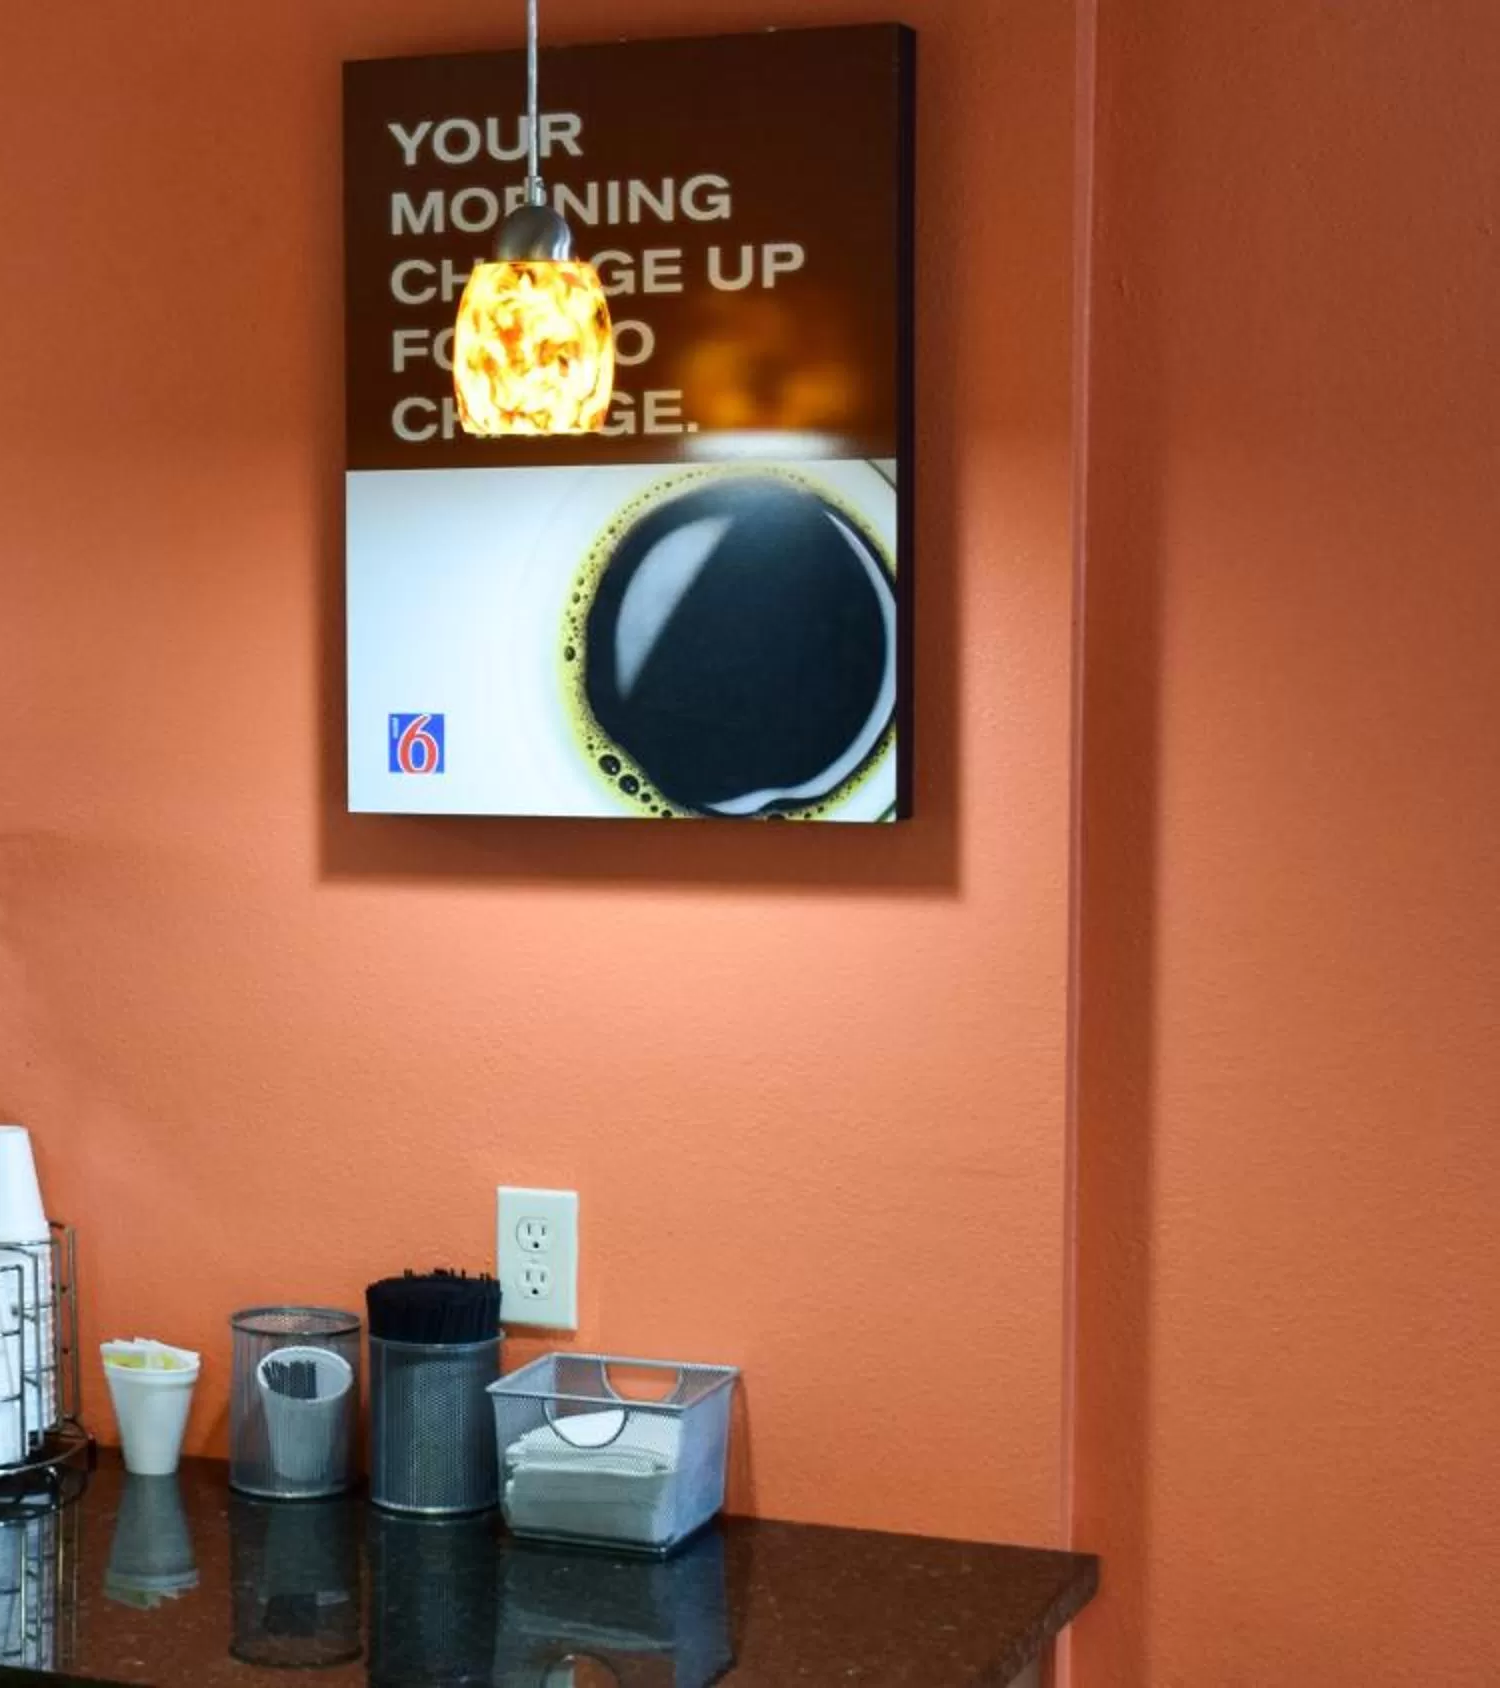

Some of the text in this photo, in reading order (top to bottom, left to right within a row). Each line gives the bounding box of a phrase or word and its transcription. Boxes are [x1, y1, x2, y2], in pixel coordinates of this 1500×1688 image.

[388, 112, 584, 165] YOUR
[389, 242, 806, 305] CHGE UP
[397, 713, 439, 777] 6
